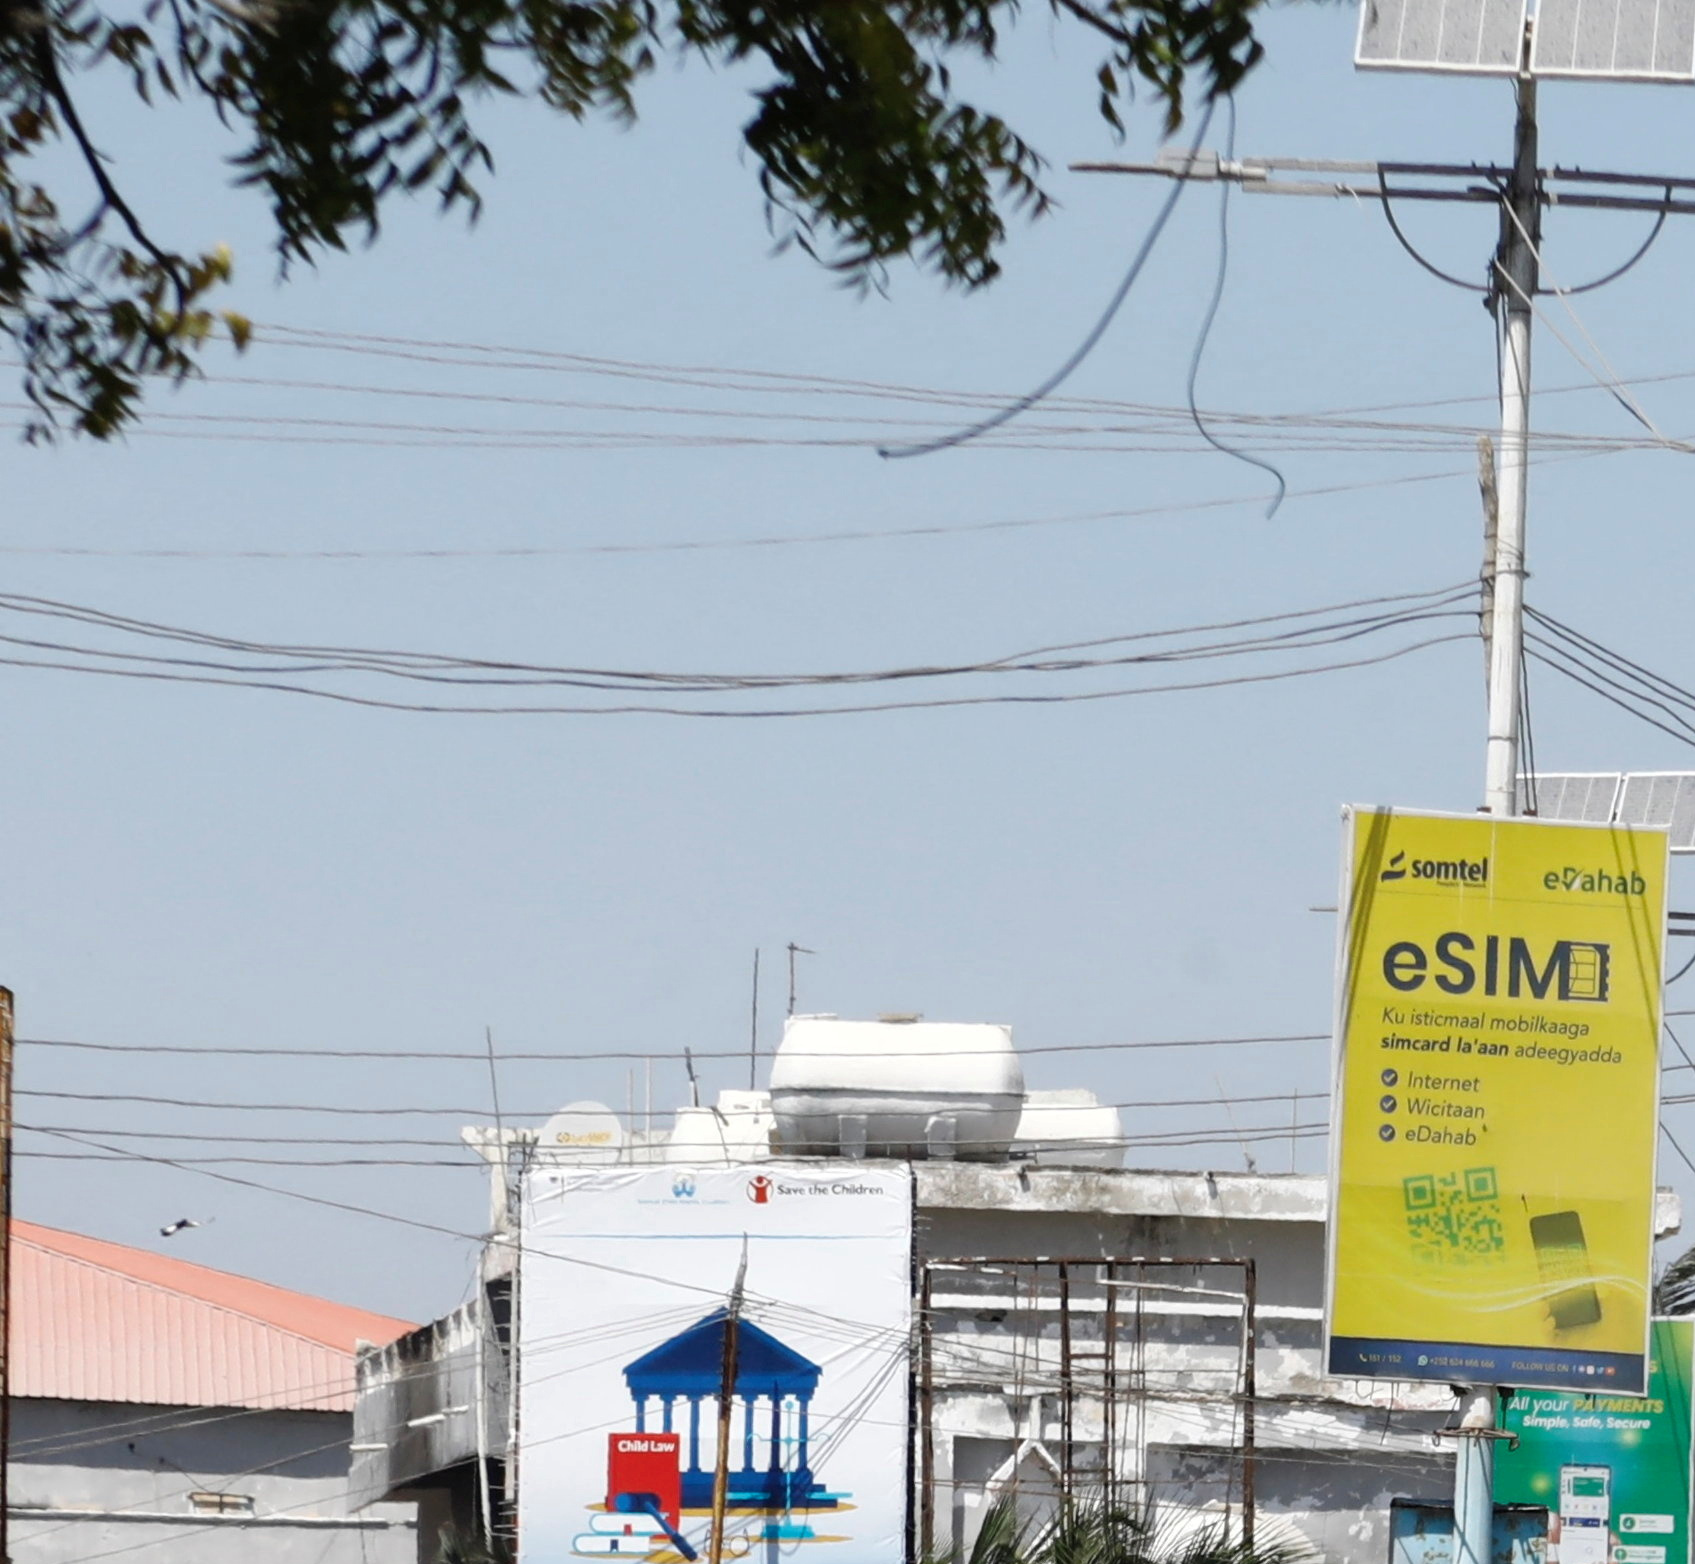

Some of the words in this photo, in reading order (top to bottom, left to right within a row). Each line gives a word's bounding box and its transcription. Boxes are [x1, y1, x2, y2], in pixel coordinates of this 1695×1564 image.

[1412, 857, 1488, 882] somtel
[1543, 867, 1646, 895] eDahab
[1383, 932, 1570, 1001] eSIM
[1382, 1007, 1405, 1025] Ku
[1410, 1009, 1485, 1029] isticmaal
[1490, 1015, 1590, 1040] mobilkaaga
[1381, 1032, 1450, 1053] simcard
[1457, 1037, 1509, 1056] la'aan
[1515, 1042, 1622, 1065] adeegyadda
[1408, 1071, 1480, 1092] Internet
[1407, 1098, 1485, 1119] Wicitaan
[1405, 1125, 1477, 1146] eDahab
[777, 1183, 805, 1195] Save
[808, 1183, 828, 1195] the
[831, 1183, 884, 1195] Children
[1509, 1396, 1530, 1410] All
[1533, 1399, 1569, 1418] your
[1574, 1398, 1664, 1413] PAYMENTS
[1523, 1415, 1569, 1430] Simple,
[1573, 1416, 1604, 1429] Safe,
[1607, 1416, 1651, 1429] Secure
[617, 1440, 649, 1452] Child
[651, 1440, 675, 1452] Law
